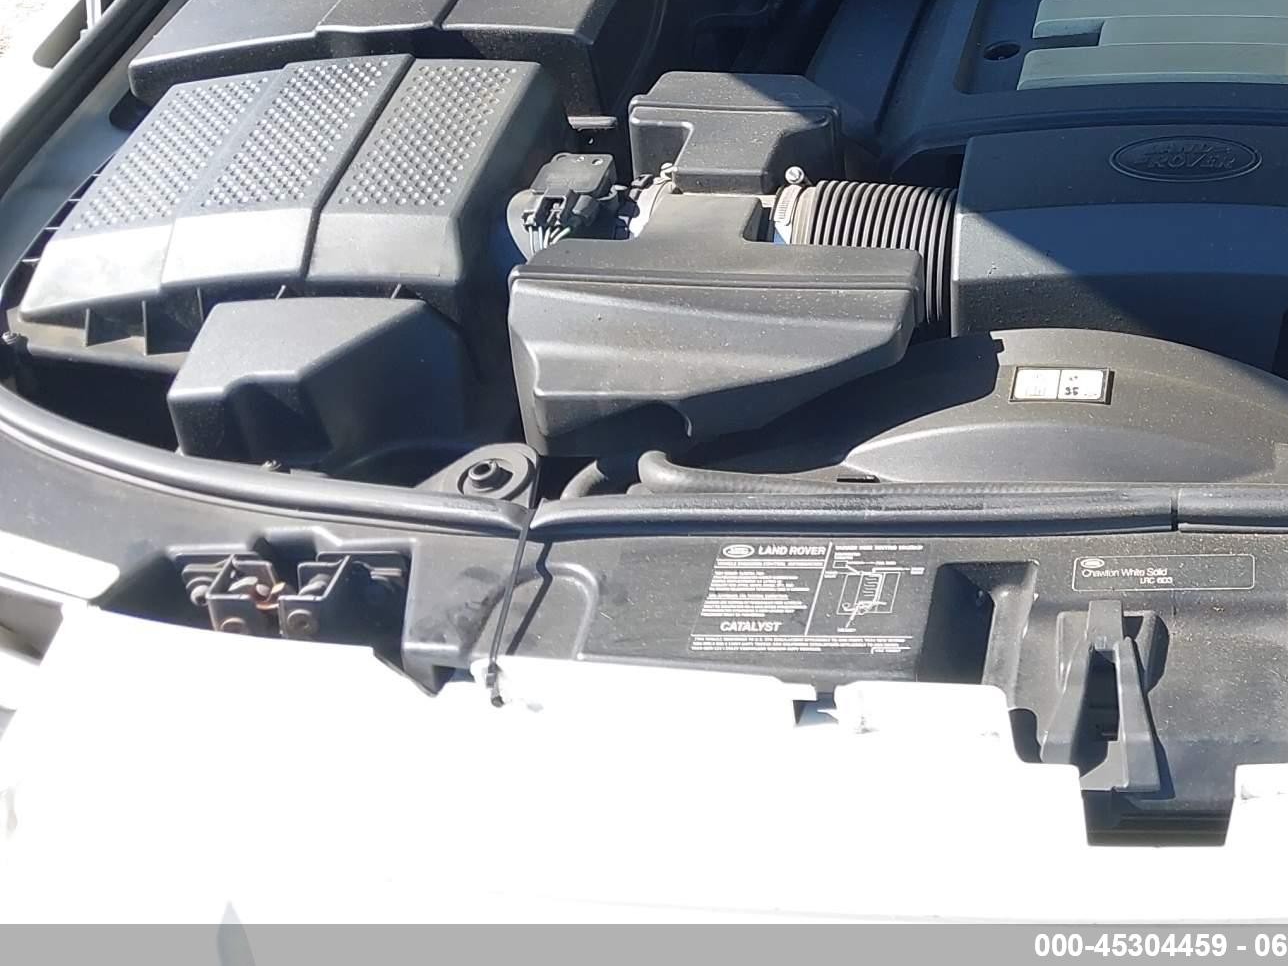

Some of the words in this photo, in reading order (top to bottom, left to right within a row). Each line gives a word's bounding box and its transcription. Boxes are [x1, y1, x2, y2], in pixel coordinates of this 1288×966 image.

[758, 545, 788, 556] LAND
[788, 546, 826, 556] ROVER
[1121, 567, 1145, 577] White
[1146, 567, 1168, 577] Solid
[719, 621, 783, 633] CATALYST
